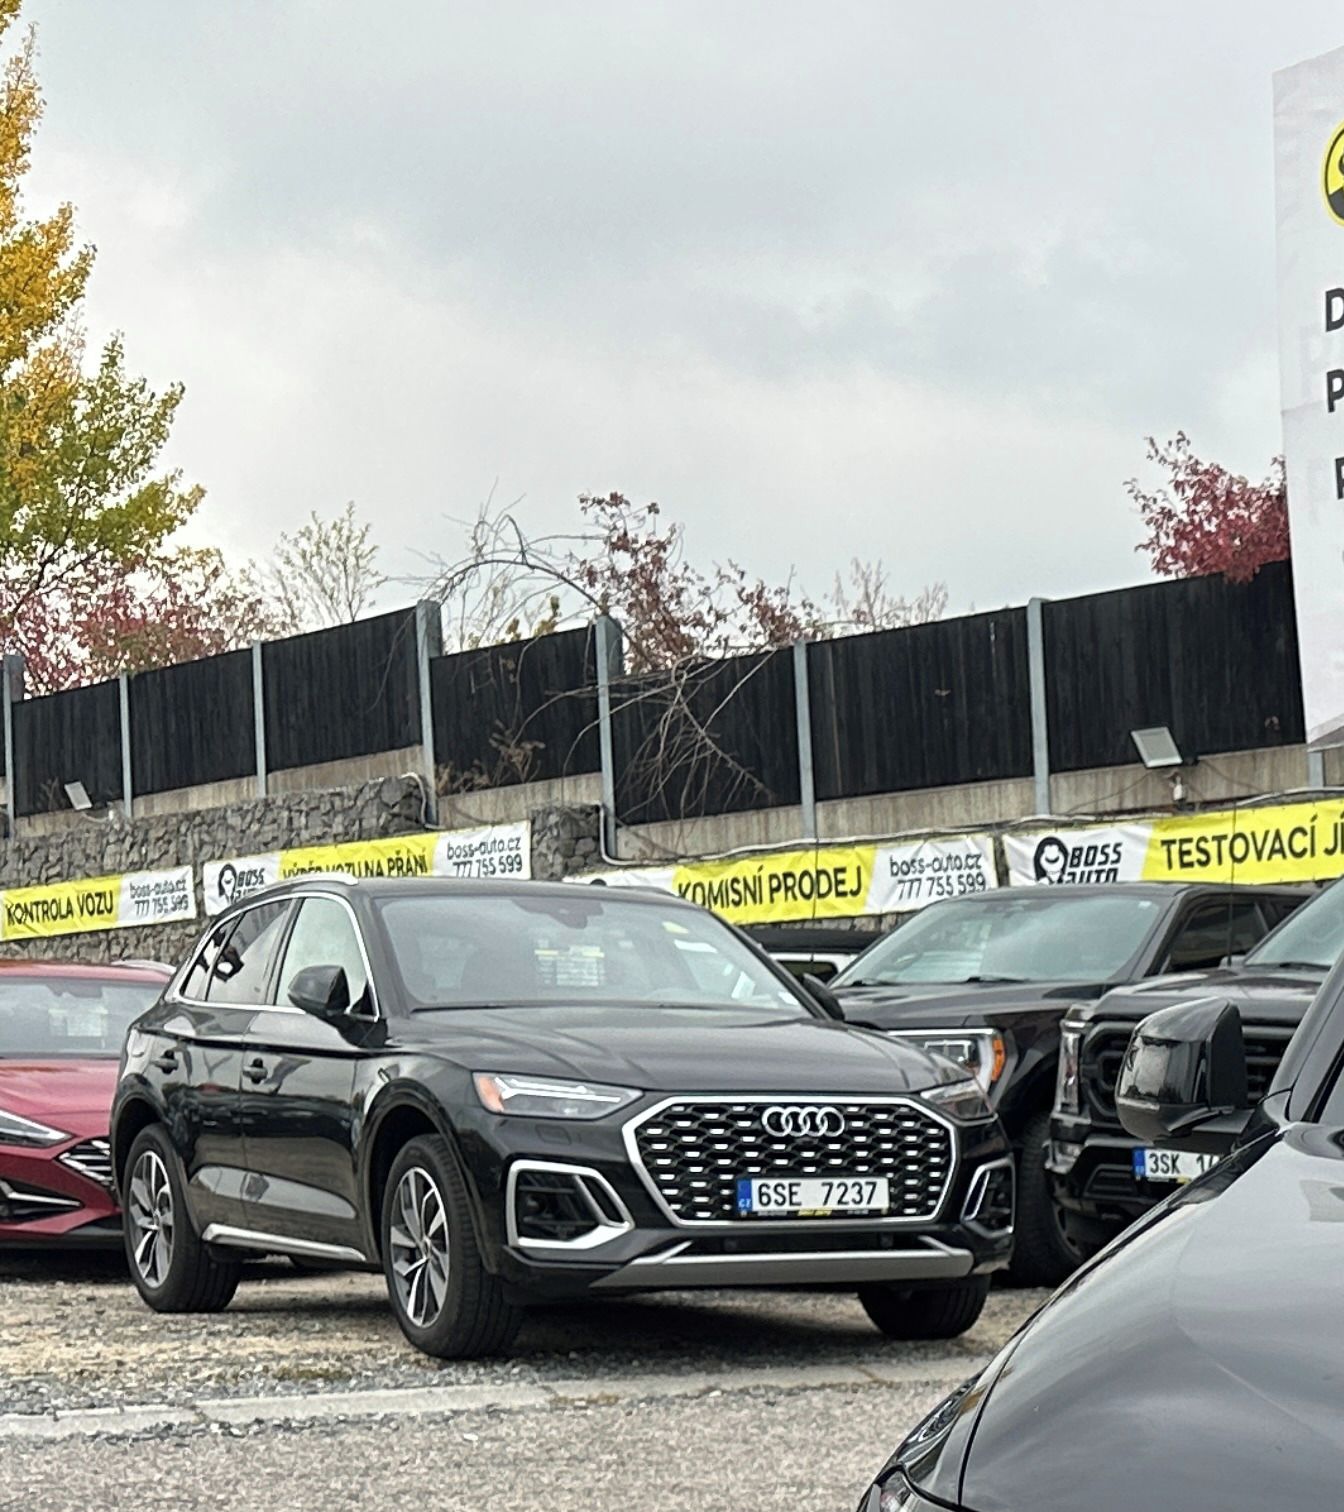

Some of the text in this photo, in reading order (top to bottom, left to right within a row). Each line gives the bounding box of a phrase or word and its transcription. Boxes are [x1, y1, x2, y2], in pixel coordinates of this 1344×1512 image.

[446, 836, 522, 861] boss-auto.cz
[1069, 842, 1123, 869] BOSS
[1160, 813, 1317, 871] TESTOVACÍ
[363, 859, 385, 878] NA
[453, 852, 523, 879] 777 755 599
[890, 853, 982, 877] boss-auto.cz
[679, 865, 863, 910] KOMISNÍ PRODEJ
[897, 872, 986, 900] 777 755 599
[5, 890, 114, 926] KONTROLA VOZU
[1149, 1152, 1181, 1175] 3SK
[757, 1182, 802, 1207] 6SE
[821, 1181, 878, 1207] 7237
